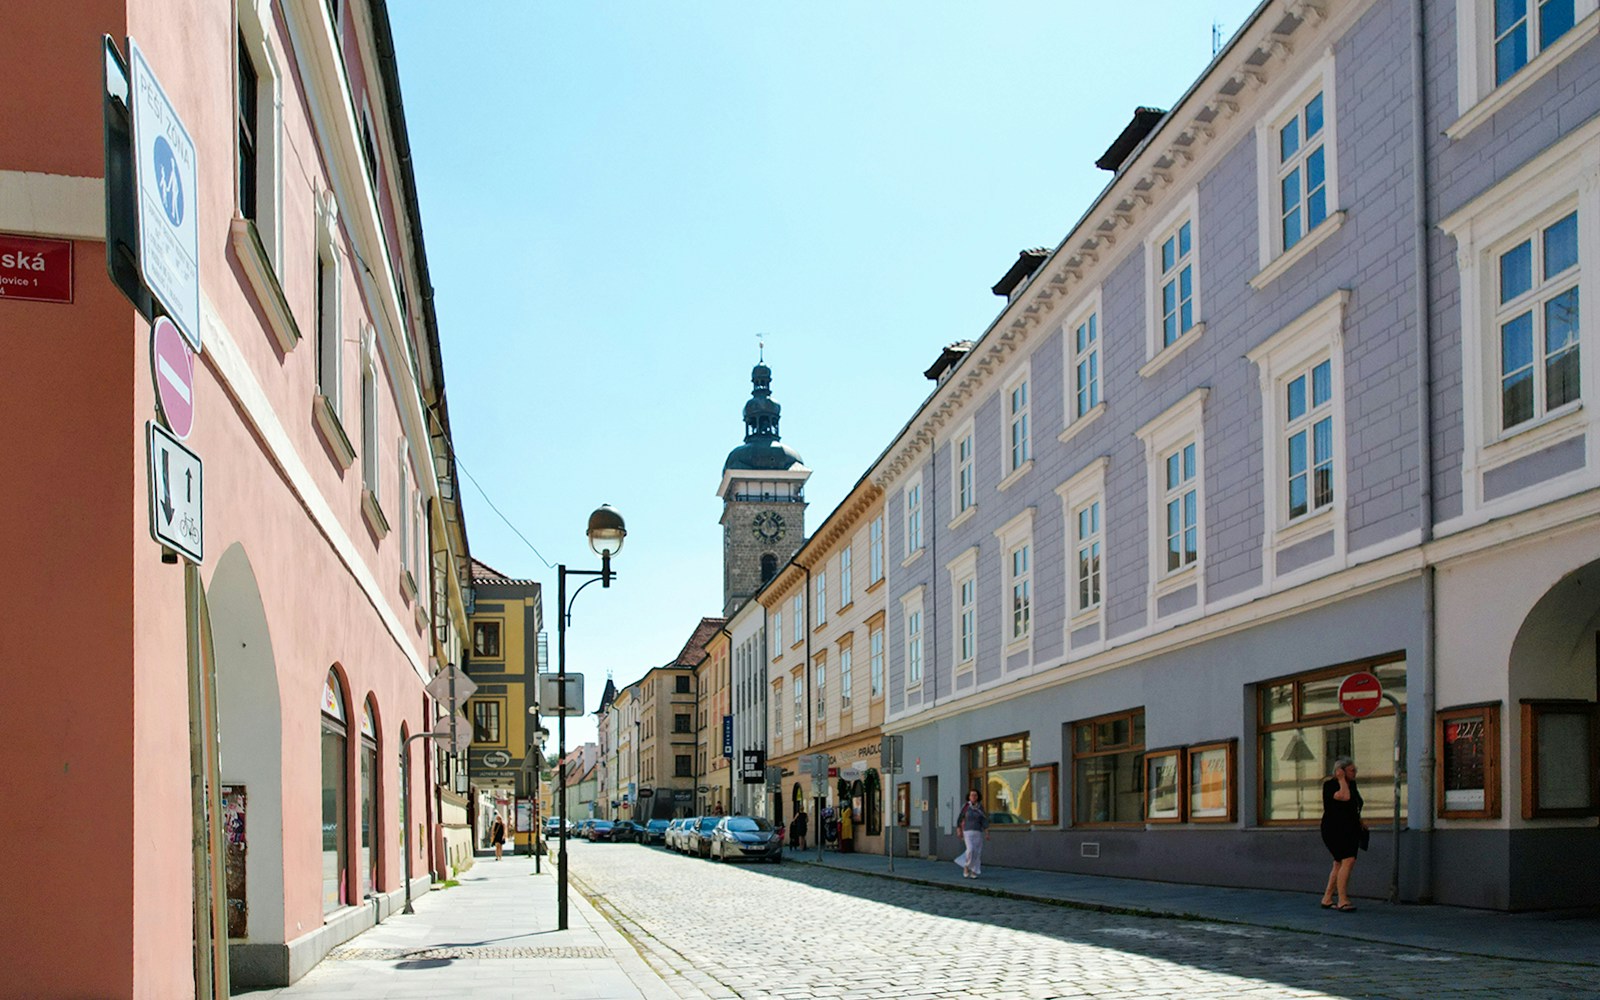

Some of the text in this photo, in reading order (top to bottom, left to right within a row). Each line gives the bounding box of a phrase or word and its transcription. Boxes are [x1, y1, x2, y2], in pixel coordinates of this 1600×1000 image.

[165, 115, 190, 170] ZÓNA
[1, 250, 46, 272] ská
[32, 277, 39, 288] 1
